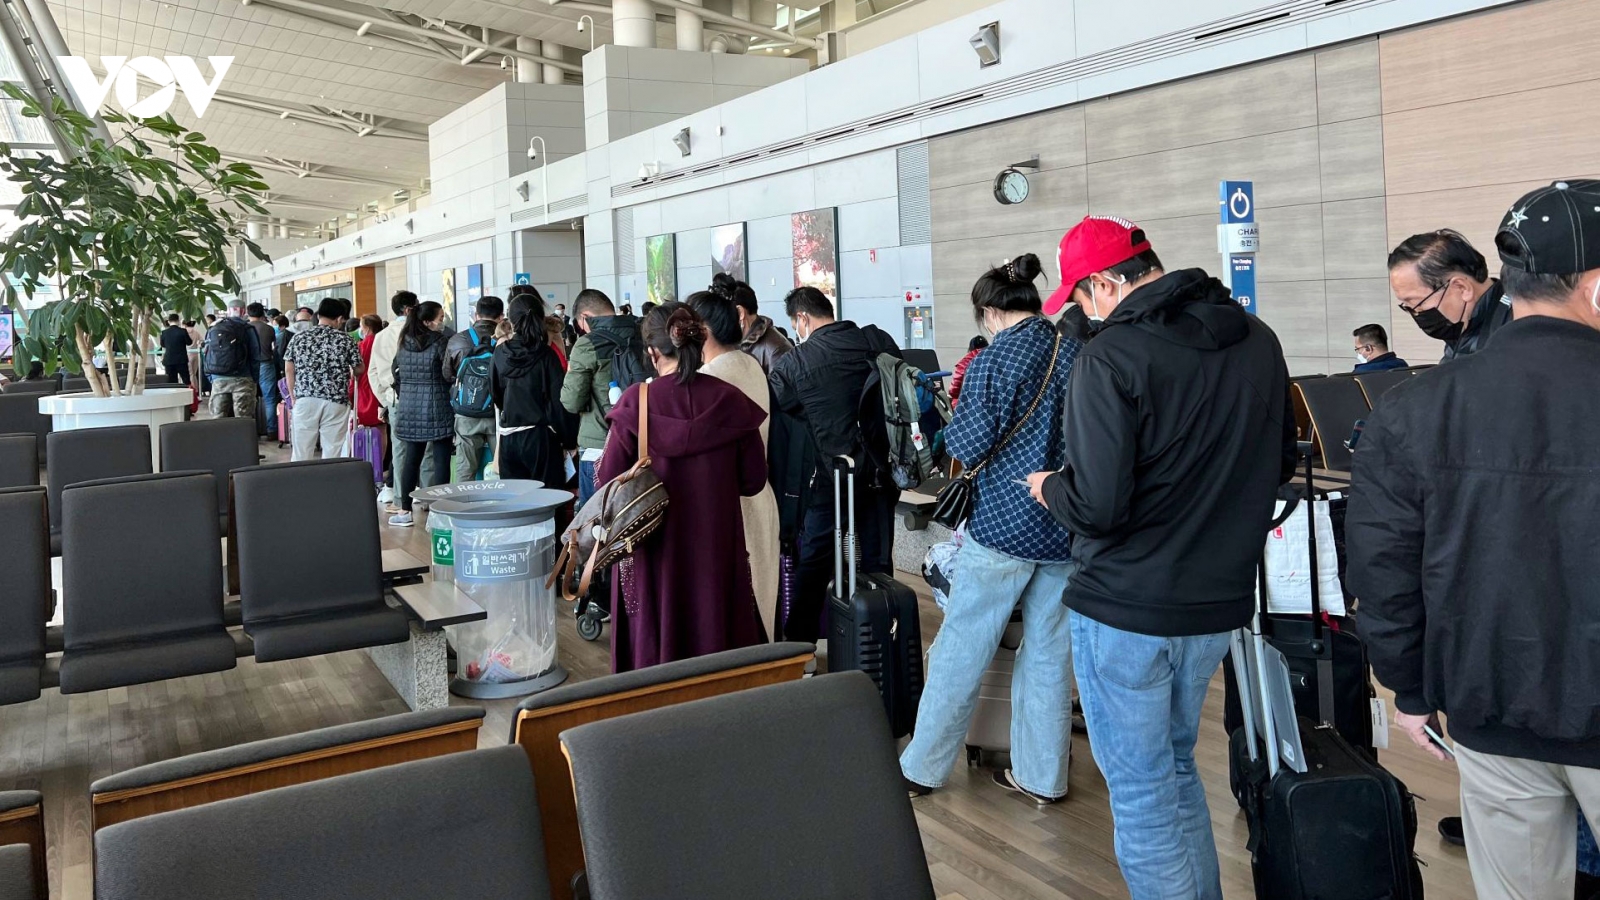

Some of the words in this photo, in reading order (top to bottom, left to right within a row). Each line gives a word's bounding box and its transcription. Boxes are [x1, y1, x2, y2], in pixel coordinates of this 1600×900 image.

[457, 481, 505, 492] Recycle
[482, 552, 525, 566] 일반쓰레기
[491, 566, 516, 575] Waste
